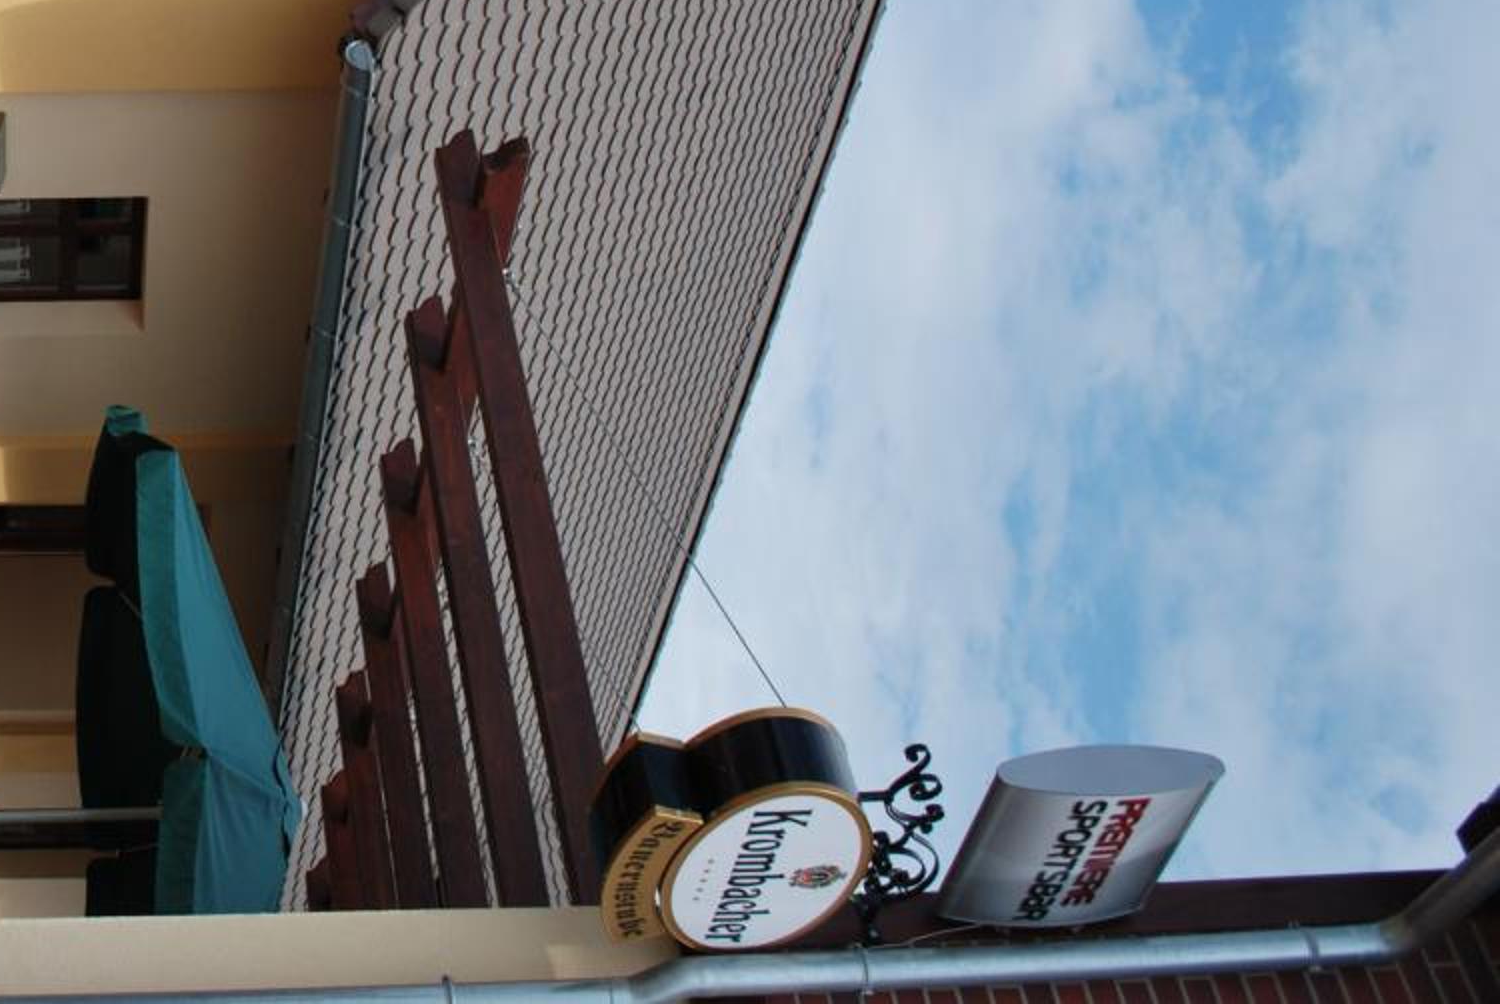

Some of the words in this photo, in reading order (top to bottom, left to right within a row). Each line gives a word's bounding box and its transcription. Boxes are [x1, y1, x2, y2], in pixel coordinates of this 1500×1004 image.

[614, 821, 684, 938] Bauernstube
[705, 809, 813, 943] Krombacher
[1060, 797, 1152, 907] PREMIERE
